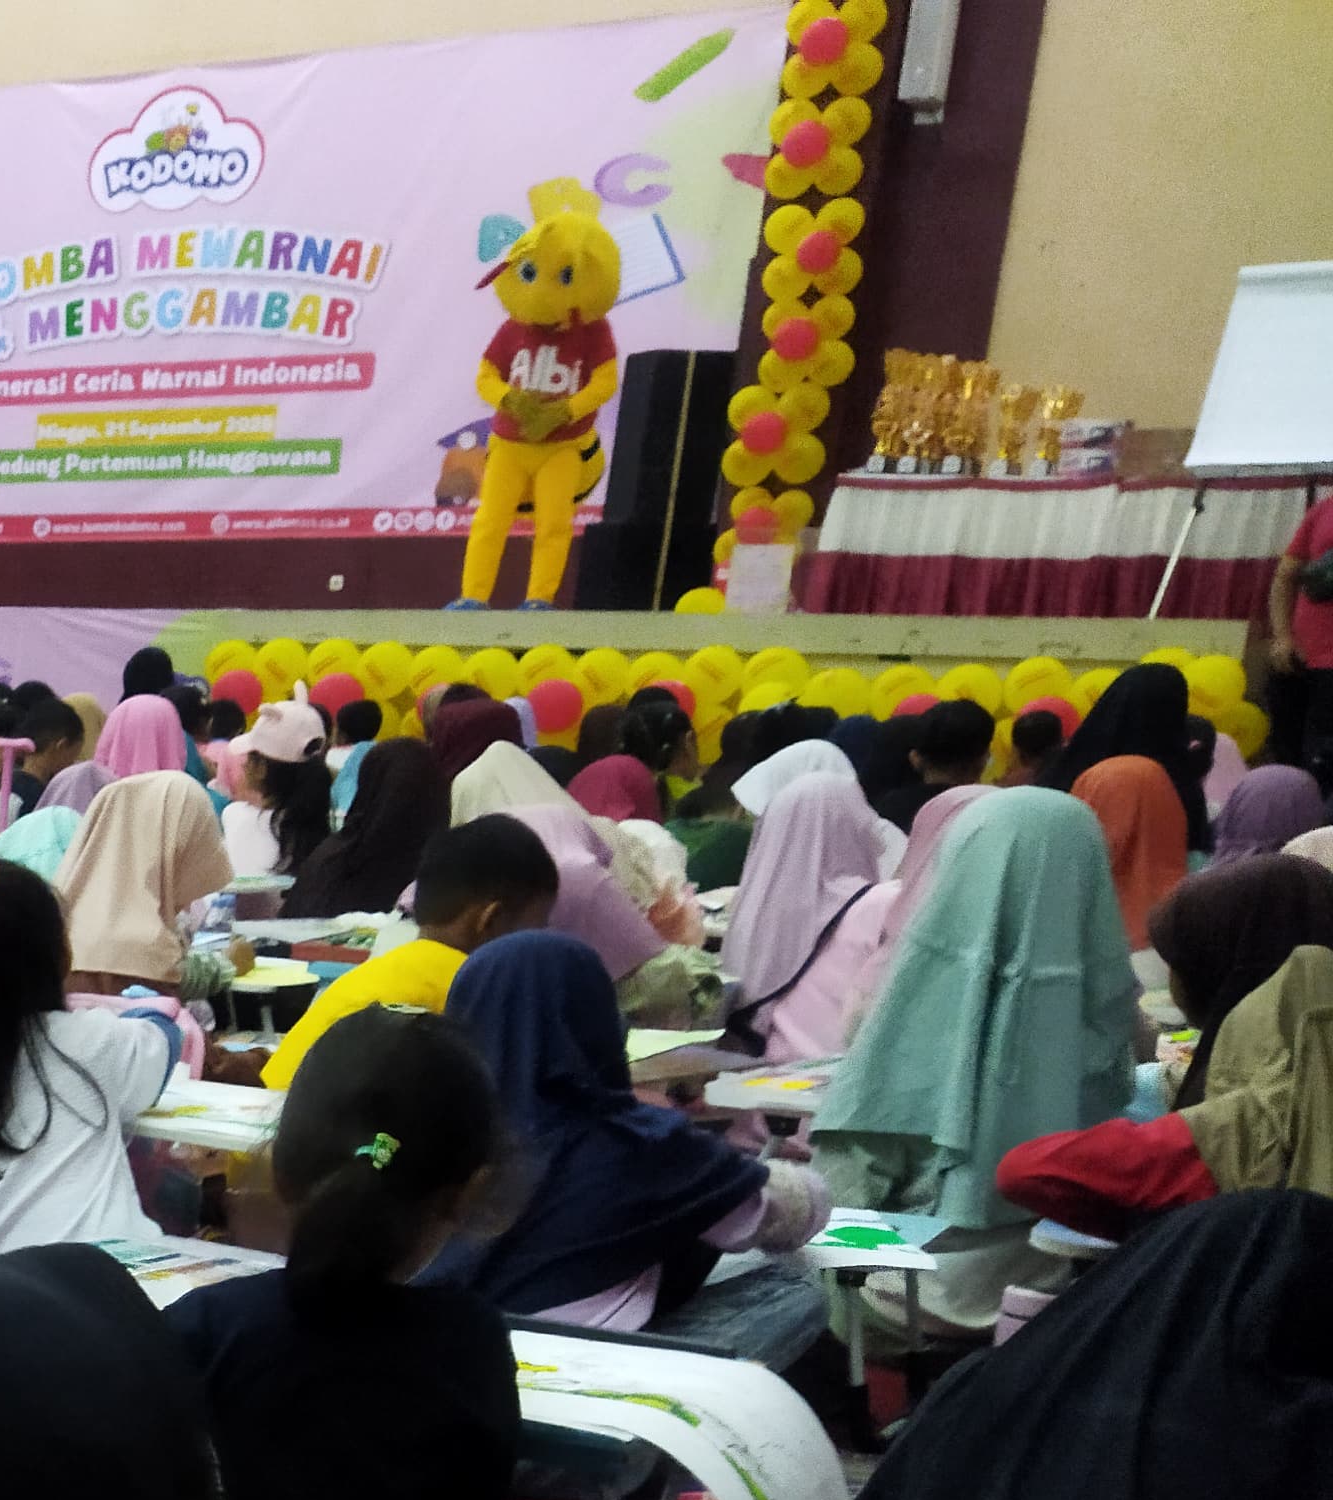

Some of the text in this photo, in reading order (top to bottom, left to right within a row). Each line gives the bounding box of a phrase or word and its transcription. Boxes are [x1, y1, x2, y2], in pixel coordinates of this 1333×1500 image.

[104, 148, 248, 198] KODOMO
[136, 228, 383, 284] MEWARNAI
[28, 288, 354, 344] MENGGAMBAR
[73, 369, 135, 394] Ceria
[141, 364, 227, 390] Warnai
[234, 357, 362, 385] Indonesia
[509, 345, 582, 394] Albi
[64, 453, 183, 474] Pertemuan
